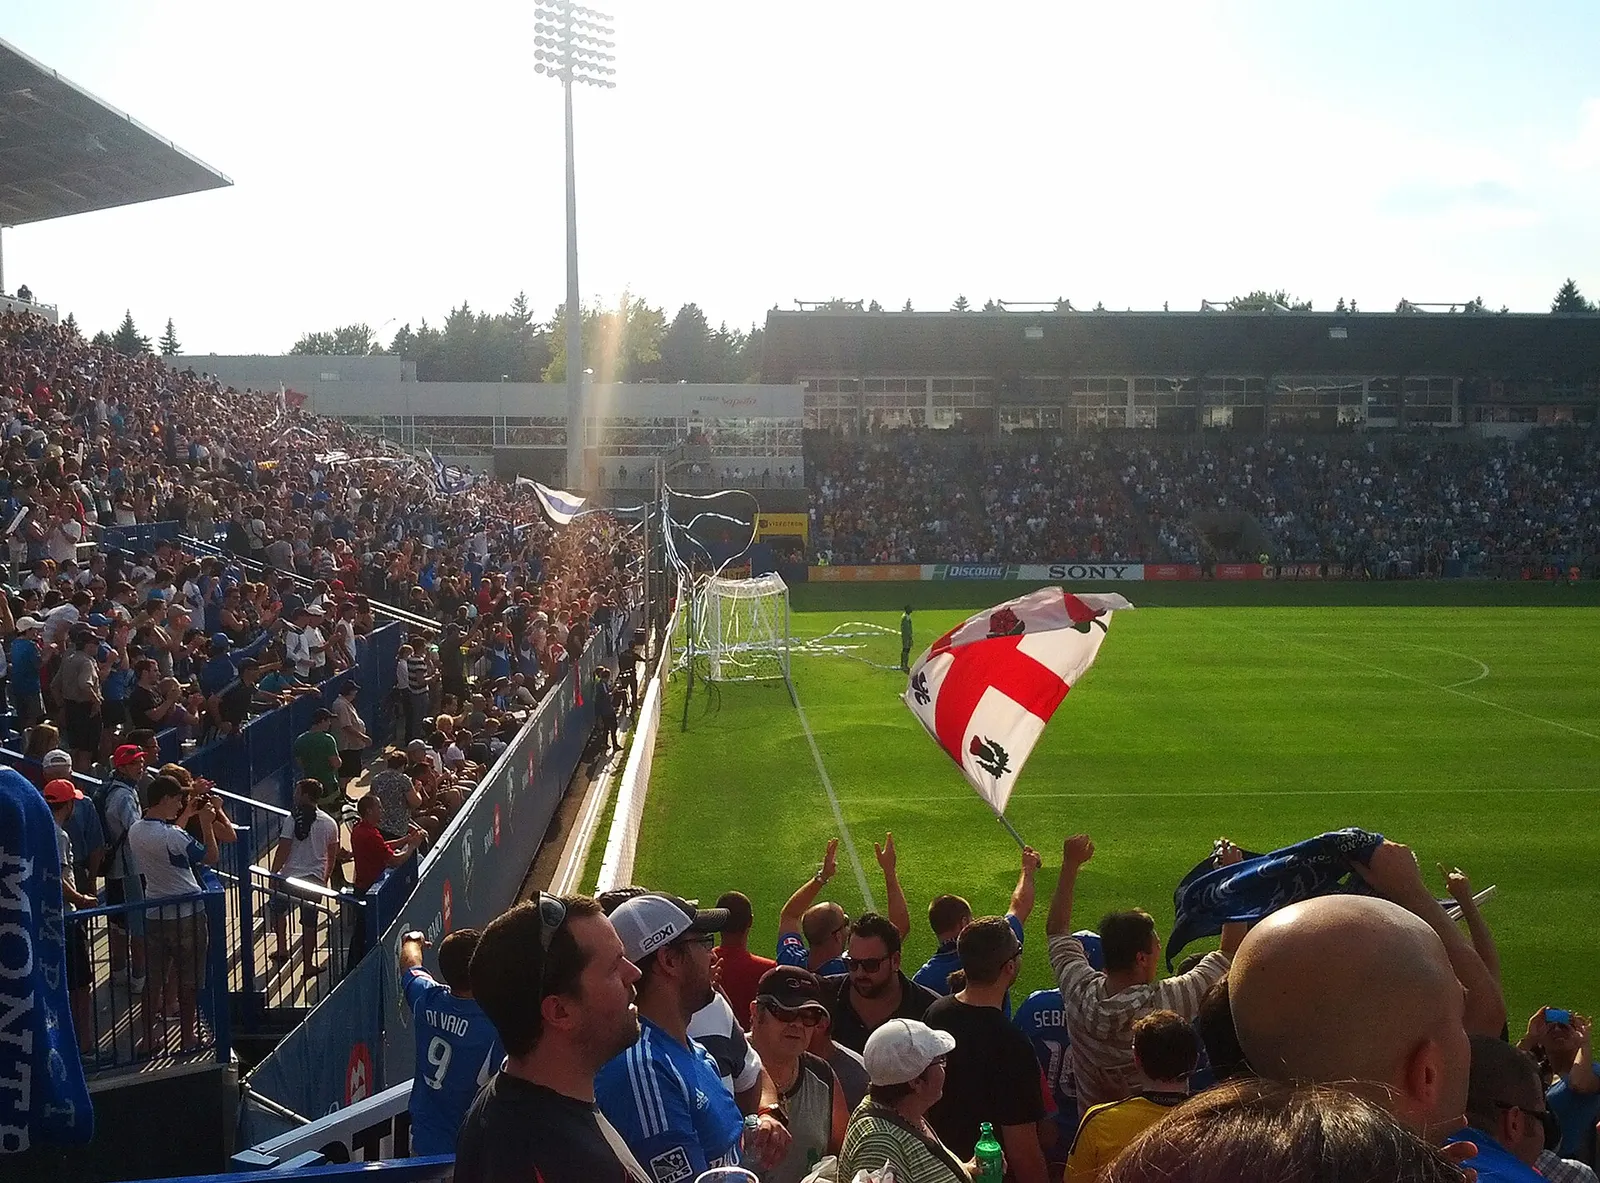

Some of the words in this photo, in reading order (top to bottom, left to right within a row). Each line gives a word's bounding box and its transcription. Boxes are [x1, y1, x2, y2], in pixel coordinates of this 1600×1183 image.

[1048, 565, 1128, 579] SONY
[425, 1010, 438, 1028] DI
[440, 1013, 469, 1037] VAIO
[423, 1035, 452, 1090] 9
